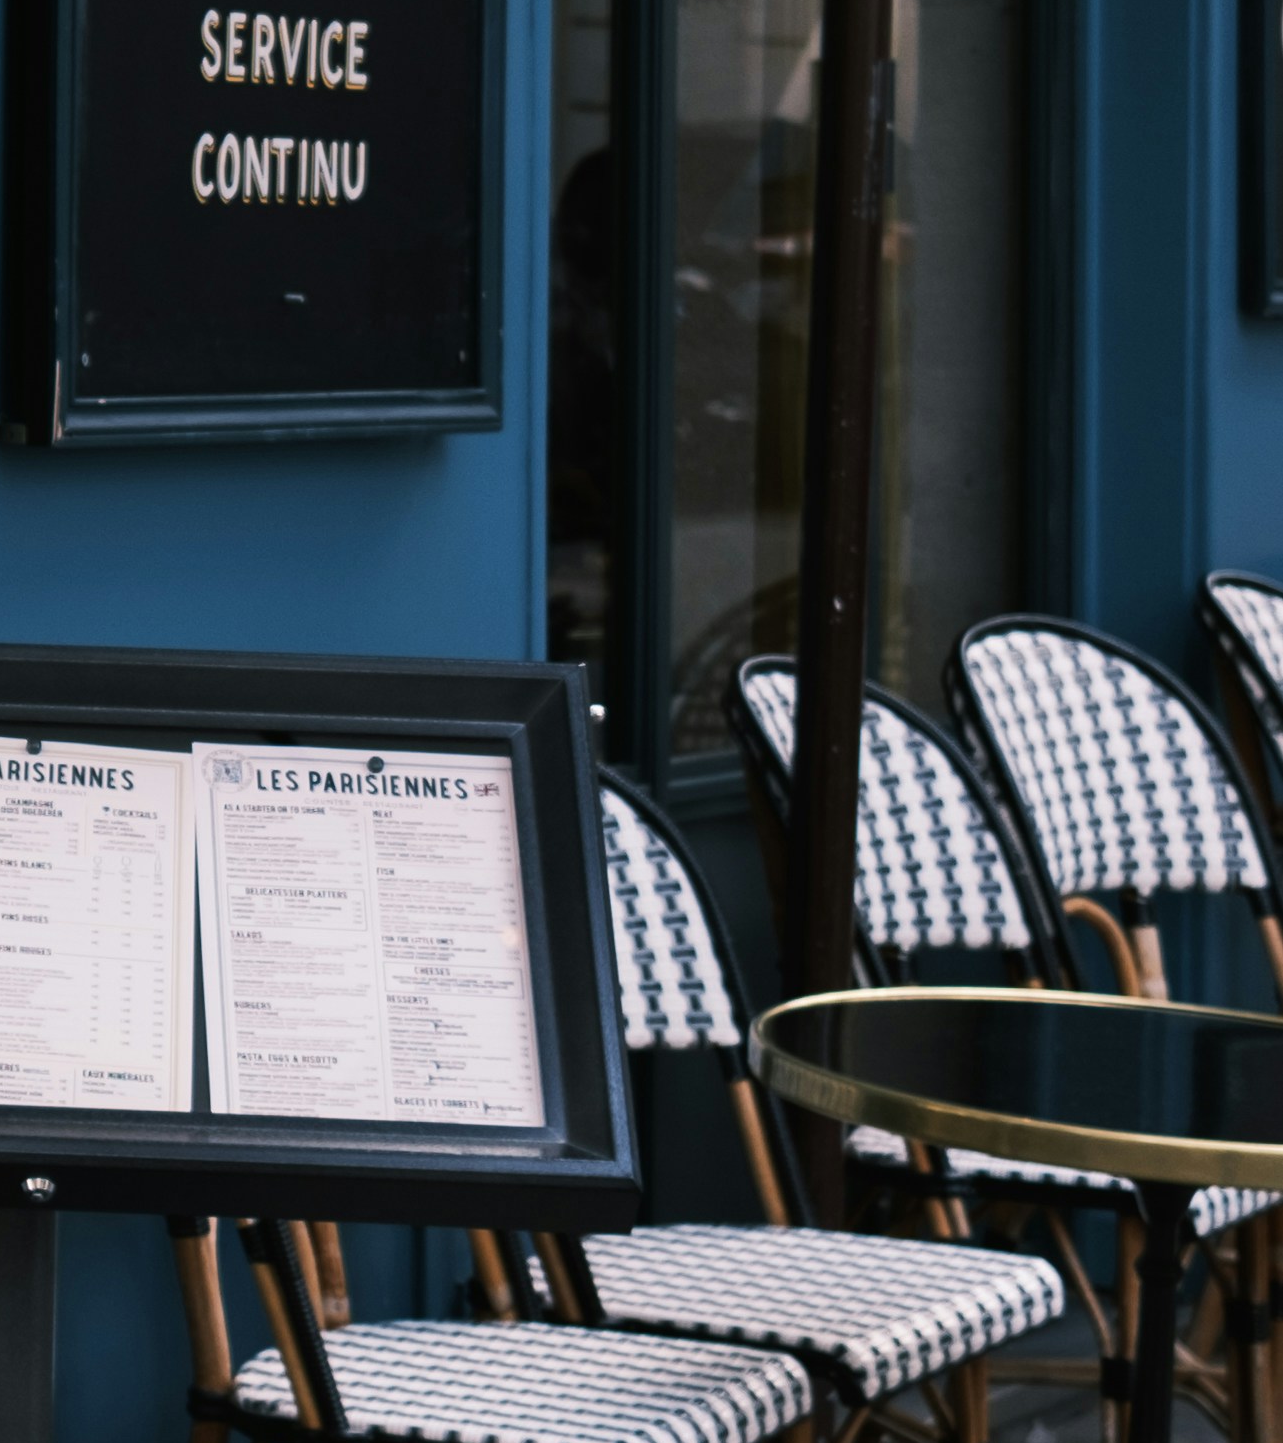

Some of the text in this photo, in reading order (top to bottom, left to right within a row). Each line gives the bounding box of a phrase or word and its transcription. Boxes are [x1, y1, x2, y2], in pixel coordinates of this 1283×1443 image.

[200, 9, 370, 91] SERVICE
[191, 132, 369, 205] CONTINU
[256, 769, 468, 800] LES PARISIENNES
